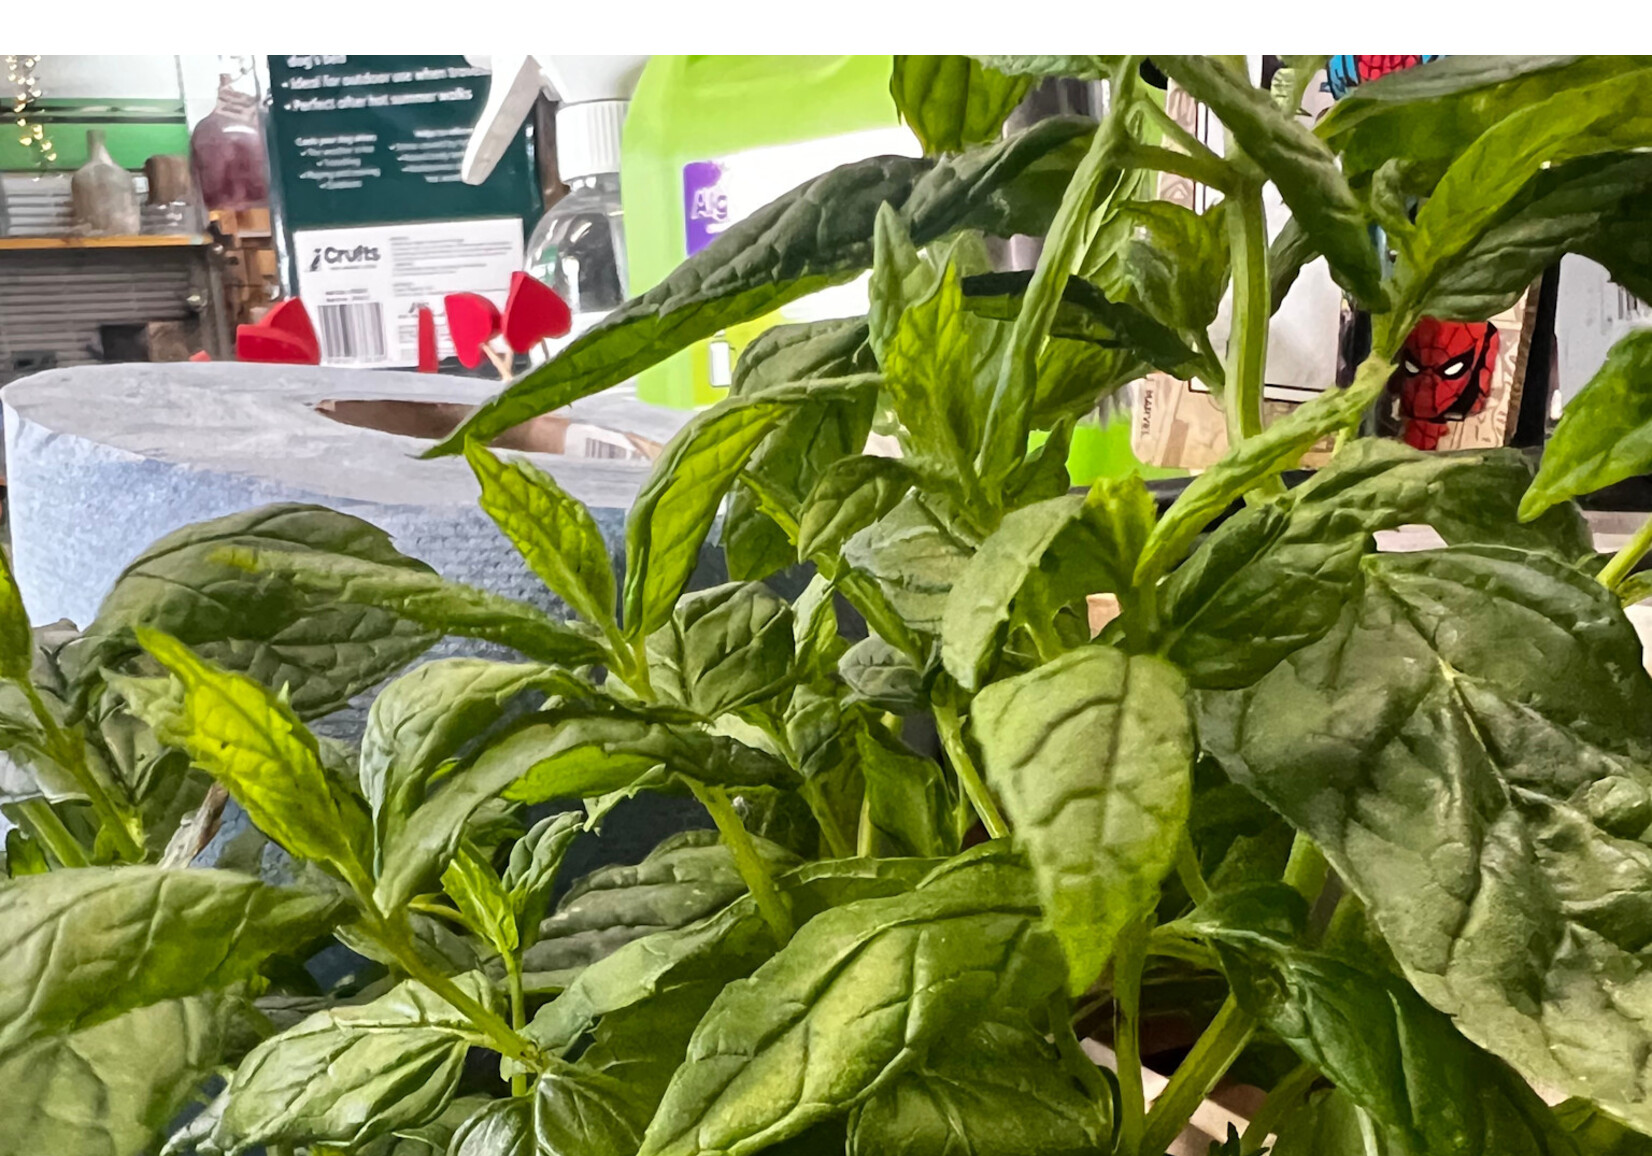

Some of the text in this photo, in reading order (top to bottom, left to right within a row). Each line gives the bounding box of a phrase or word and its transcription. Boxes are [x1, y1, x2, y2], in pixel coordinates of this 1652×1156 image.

[341, 72, 391, 87] outdoor
[293, 97, 336, 112] Perfect
[324, 244, 382, 264] Crufts
